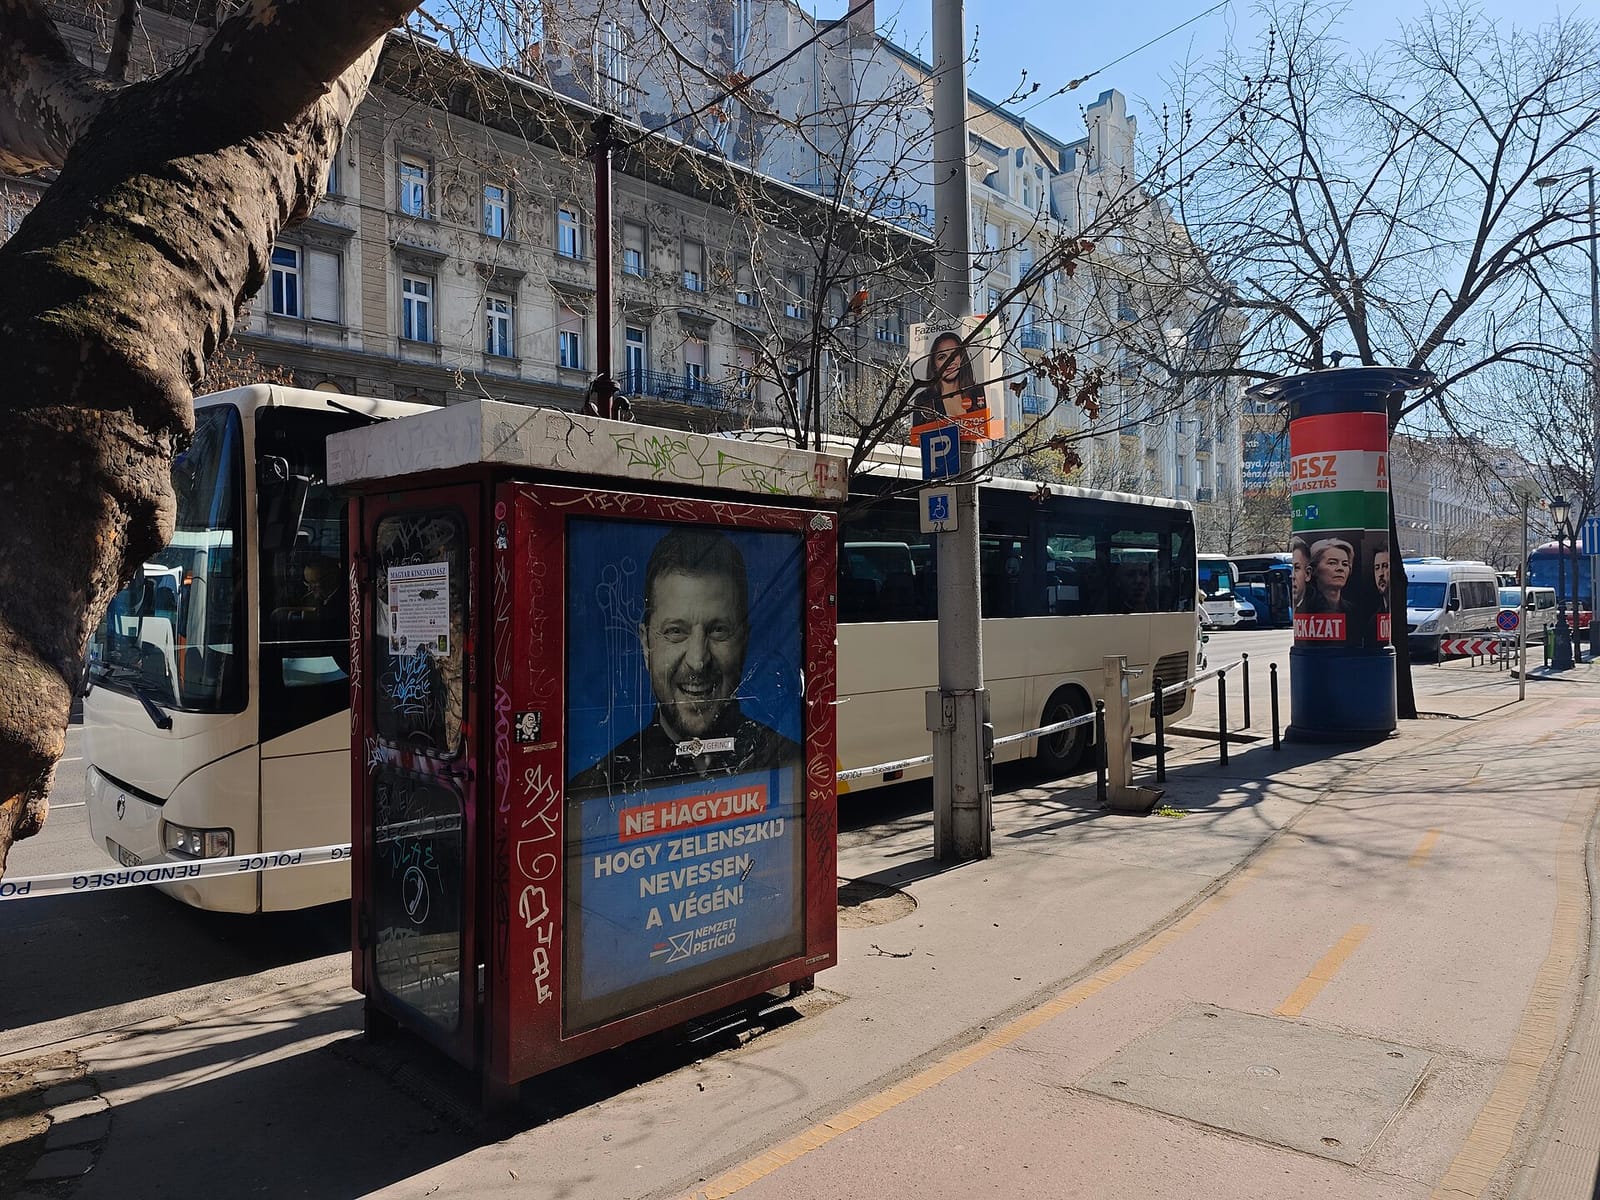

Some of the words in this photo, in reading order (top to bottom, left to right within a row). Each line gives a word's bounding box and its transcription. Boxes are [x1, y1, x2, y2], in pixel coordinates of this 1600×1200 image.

[929, 435, 951, 473] P
[625, 810, 656, 836] NE
[660, 791, 765, 829] HAGYJUK,
[238, 852, 302, 871] POLICE
[594, 843, 661, 879] HOGY
[667, 817, 785, 862] ZELENSZKIJ
[639, 853, 750, 898] NEVESSEN
[645, 907, 663, 930] A
[668, 884, 744, 923] VÉGÉN!
[692, 929, 736, 956] PETÍCIÓ
[694, 918, 737, 939] NEMZETI
